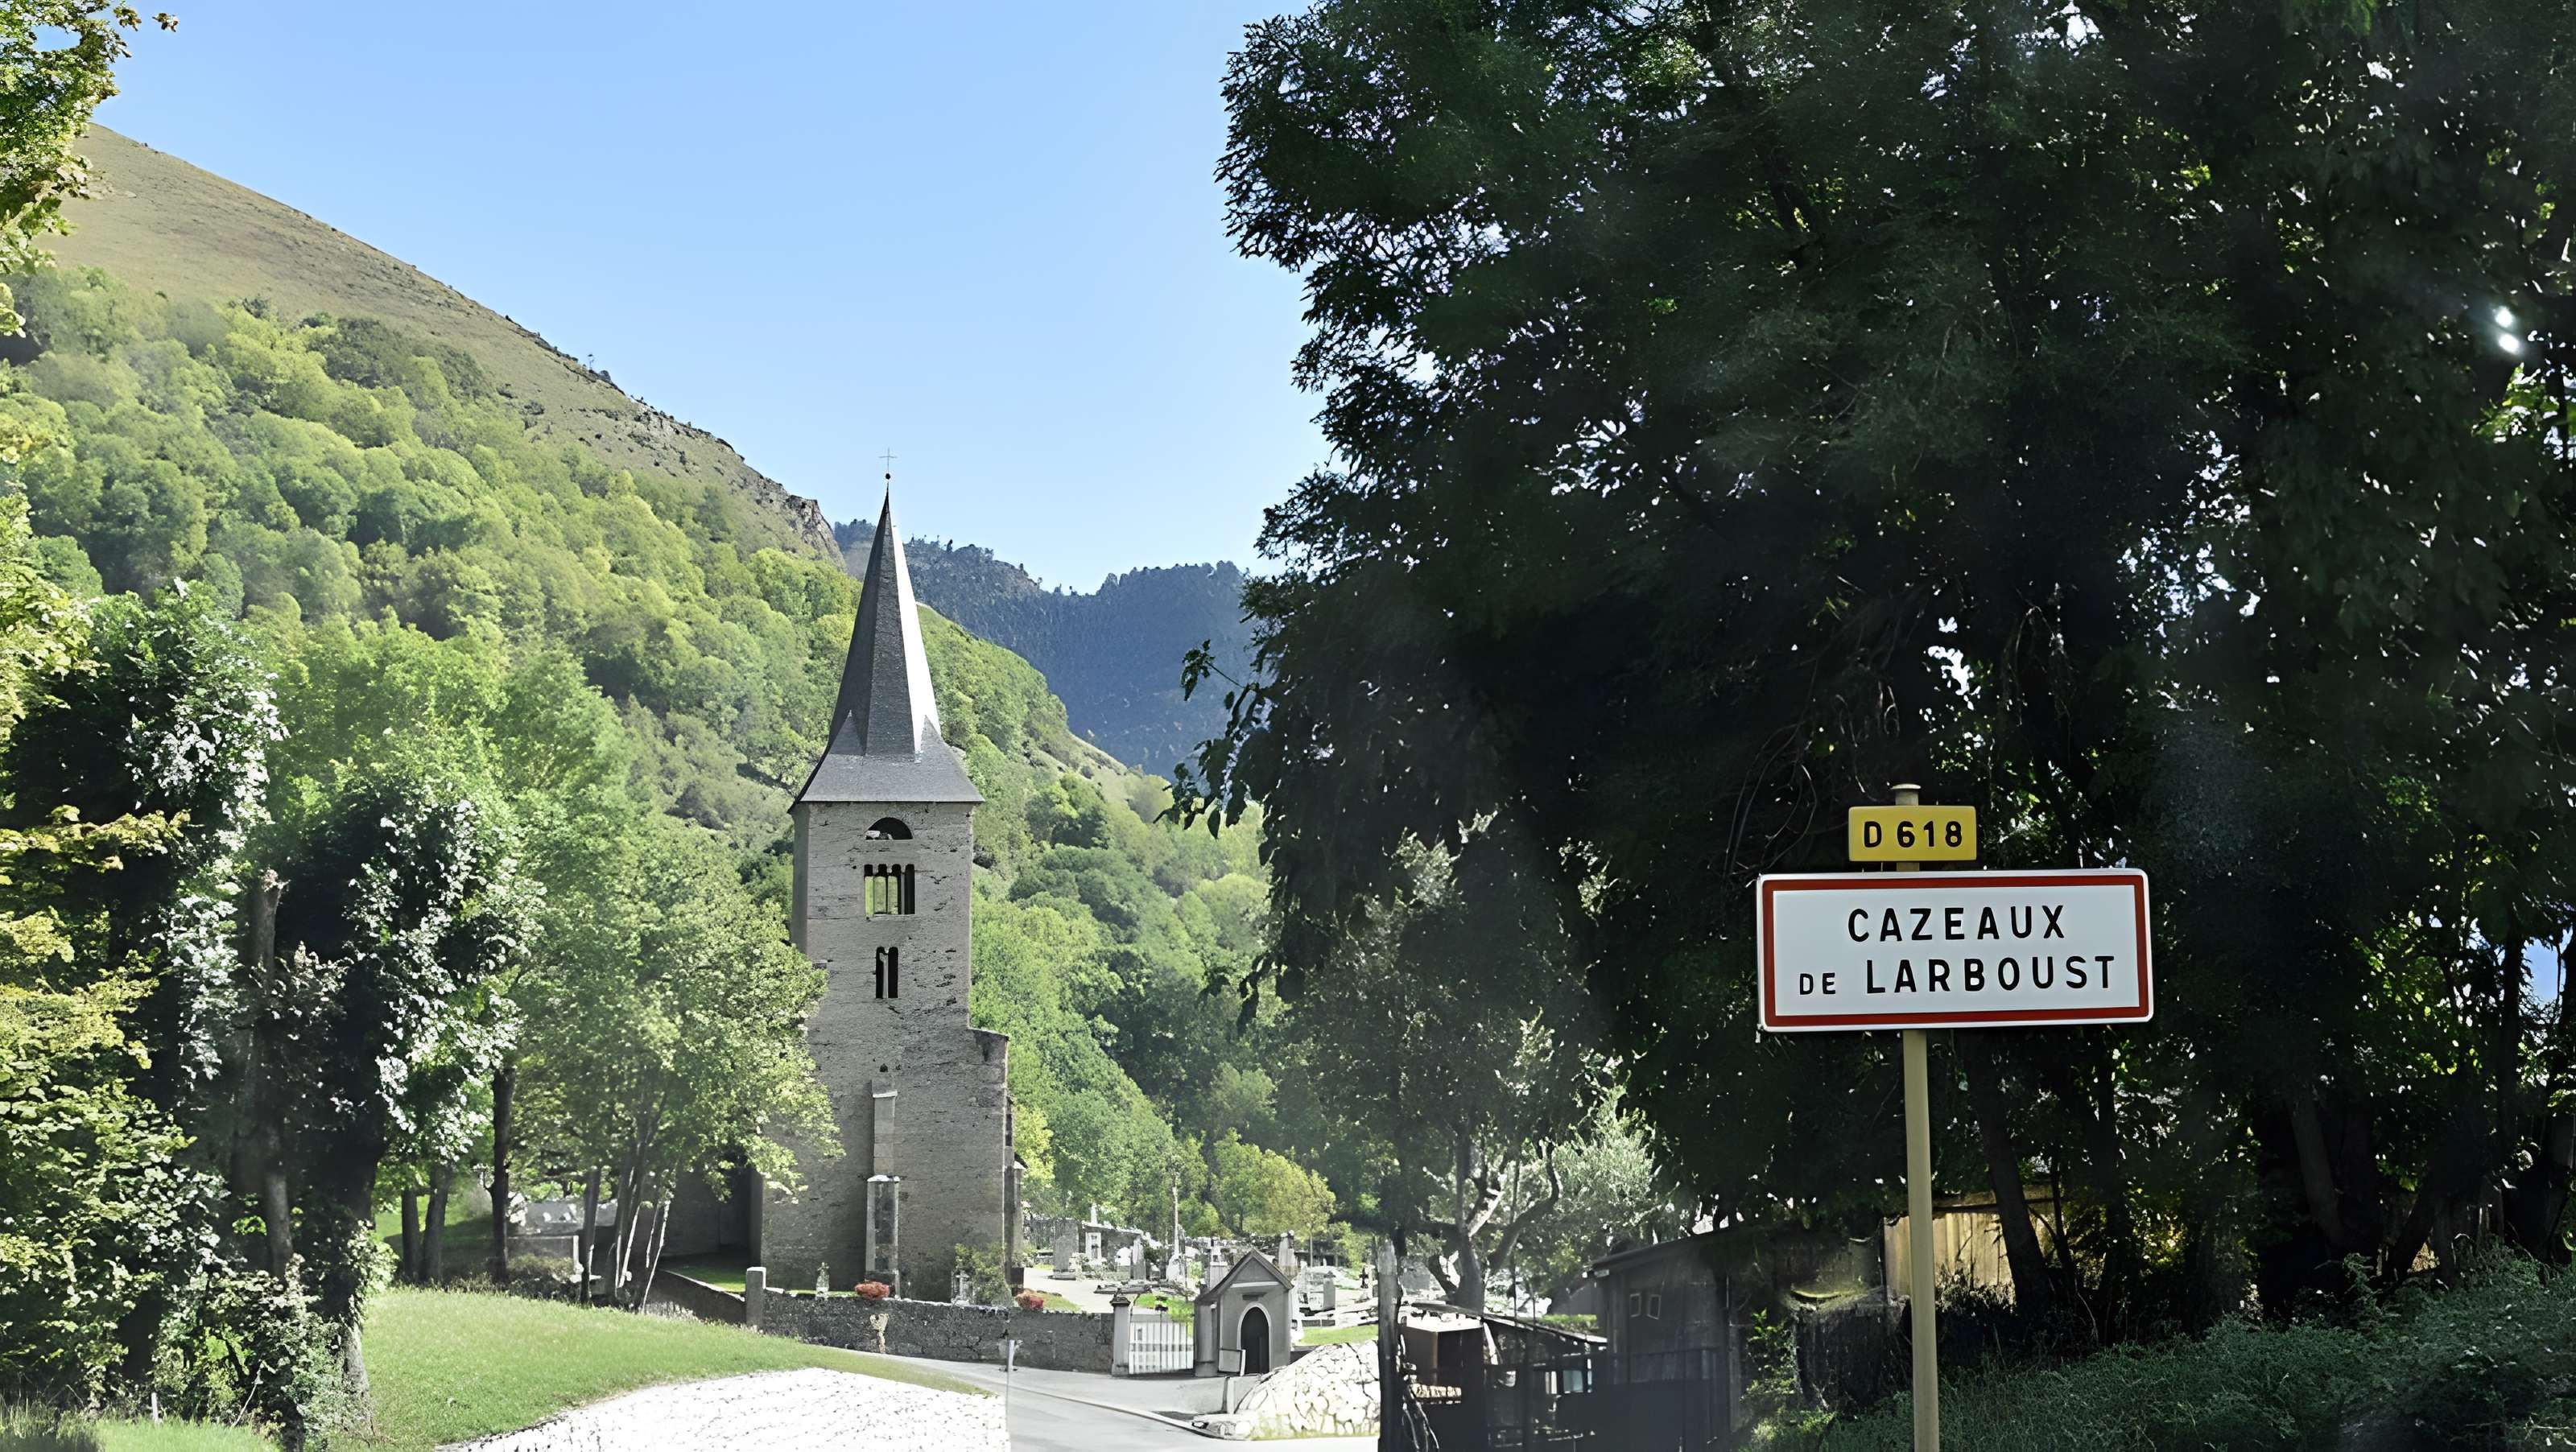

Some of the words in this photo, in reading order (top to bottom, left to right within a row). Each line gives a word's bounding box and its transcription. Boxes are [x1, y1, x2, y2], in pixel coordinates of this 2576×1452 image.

[1864, 821, 1882, 848] D
[1897, 820, 1963, 848] 618
[1848, 905, 2065, 942] CAZEAUX
[1799, 972, 1836, 996] DE
[1866, 955, 2115, 994] LARBOUST
